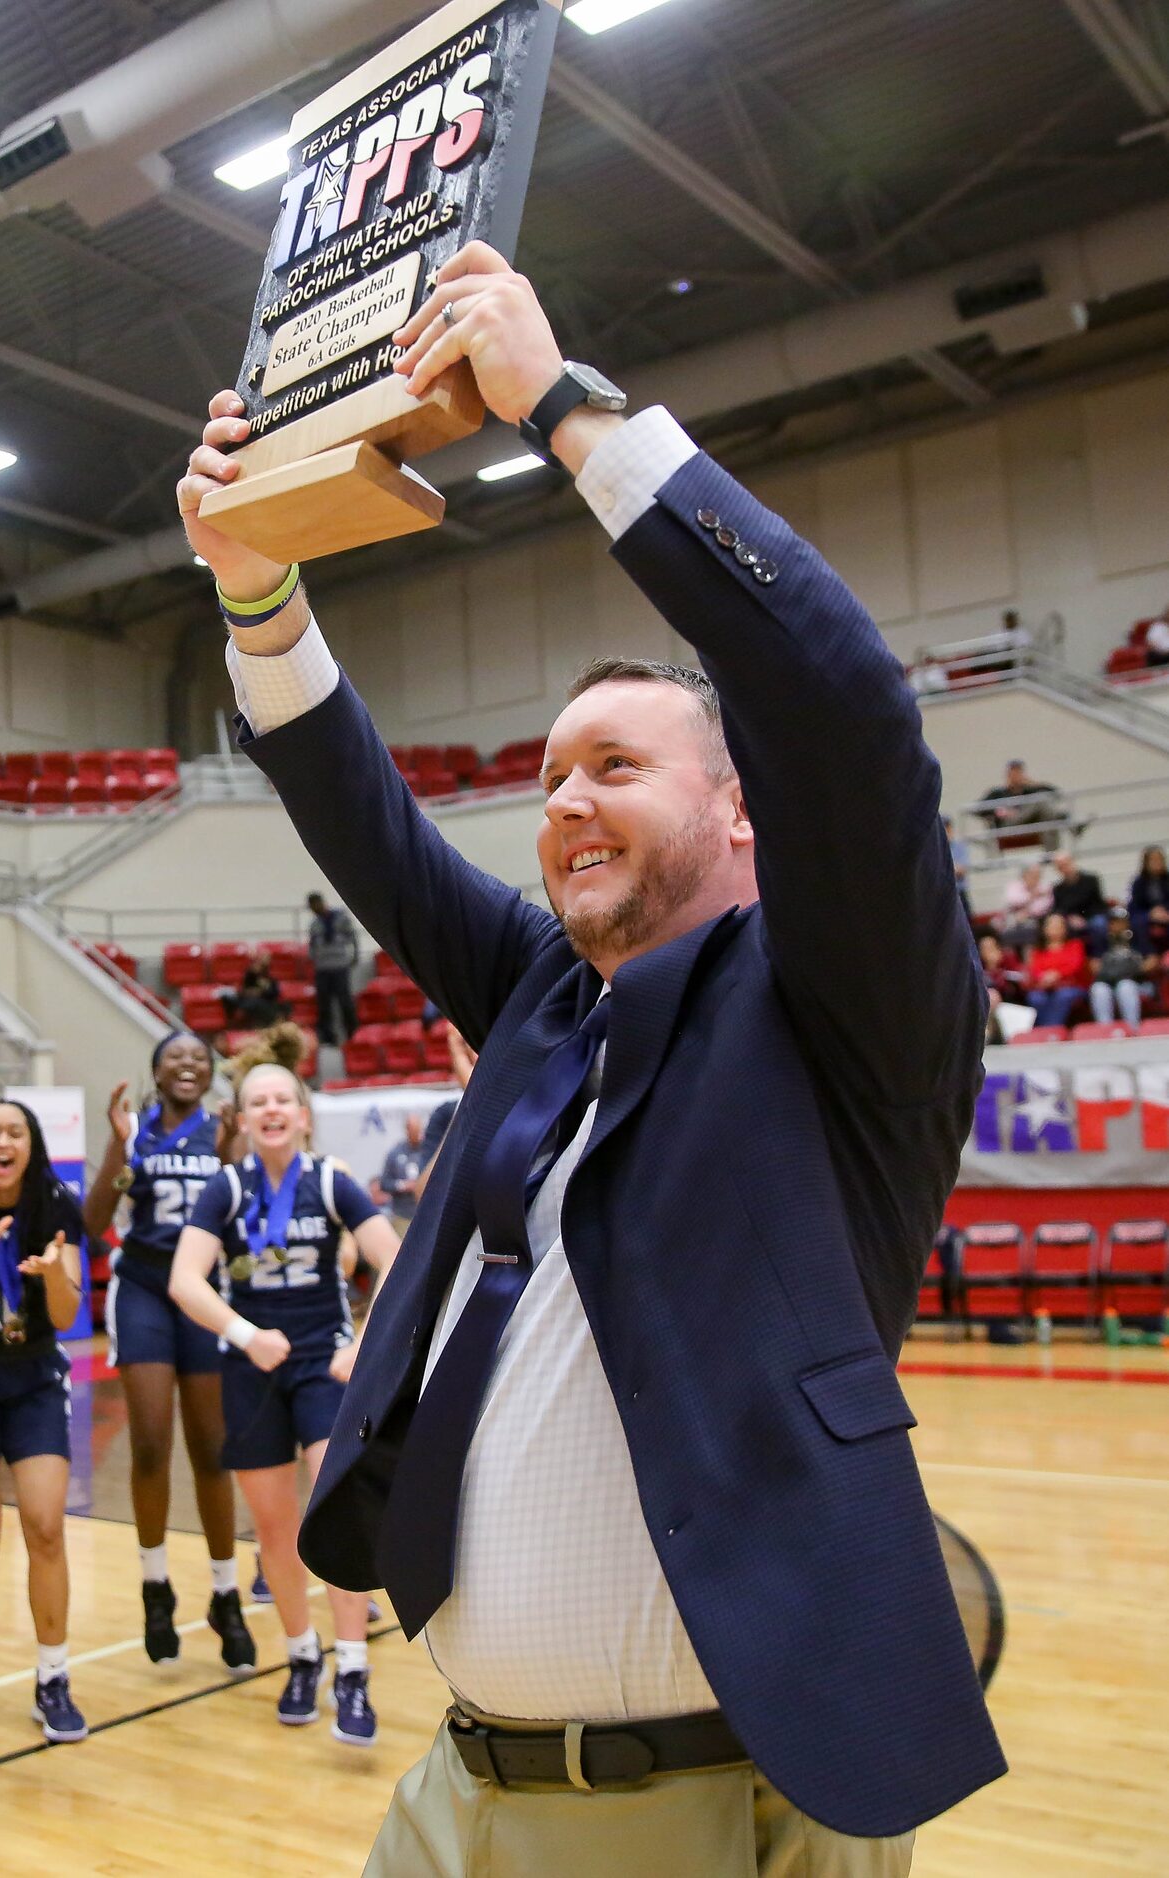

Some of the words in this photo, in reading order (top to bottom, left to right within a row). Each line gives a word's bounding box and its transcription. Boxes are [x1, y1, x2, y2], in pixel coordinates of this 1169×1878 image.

[301, 116, 353, 163] TEXAS
[356, 25, 487, 127] ASSOCIATION
[273, 53, 492, 270] TAPPS
[260, 260, 356, 326] PAROCHIAL
[360, 200, 454, 268] SCHOOLS
[287, 259, 311, 288] OF
[313, 215, 387, 273] PRIVATE
[390, 191, 432, 228] AND
[272, 337, 312, 369] State
[316, 287, 405, 345] Champion
[293, 310, 322, 337] 2020
[327, 268, 395, 318] Basketball
[250, 381, 327, 432] mpetition
[331, 357, 370, 392] with
[375, 344, 407, 371] Ho
[307, 351, 324, 369] 6A
[328, 334, 356, 357] Girls
